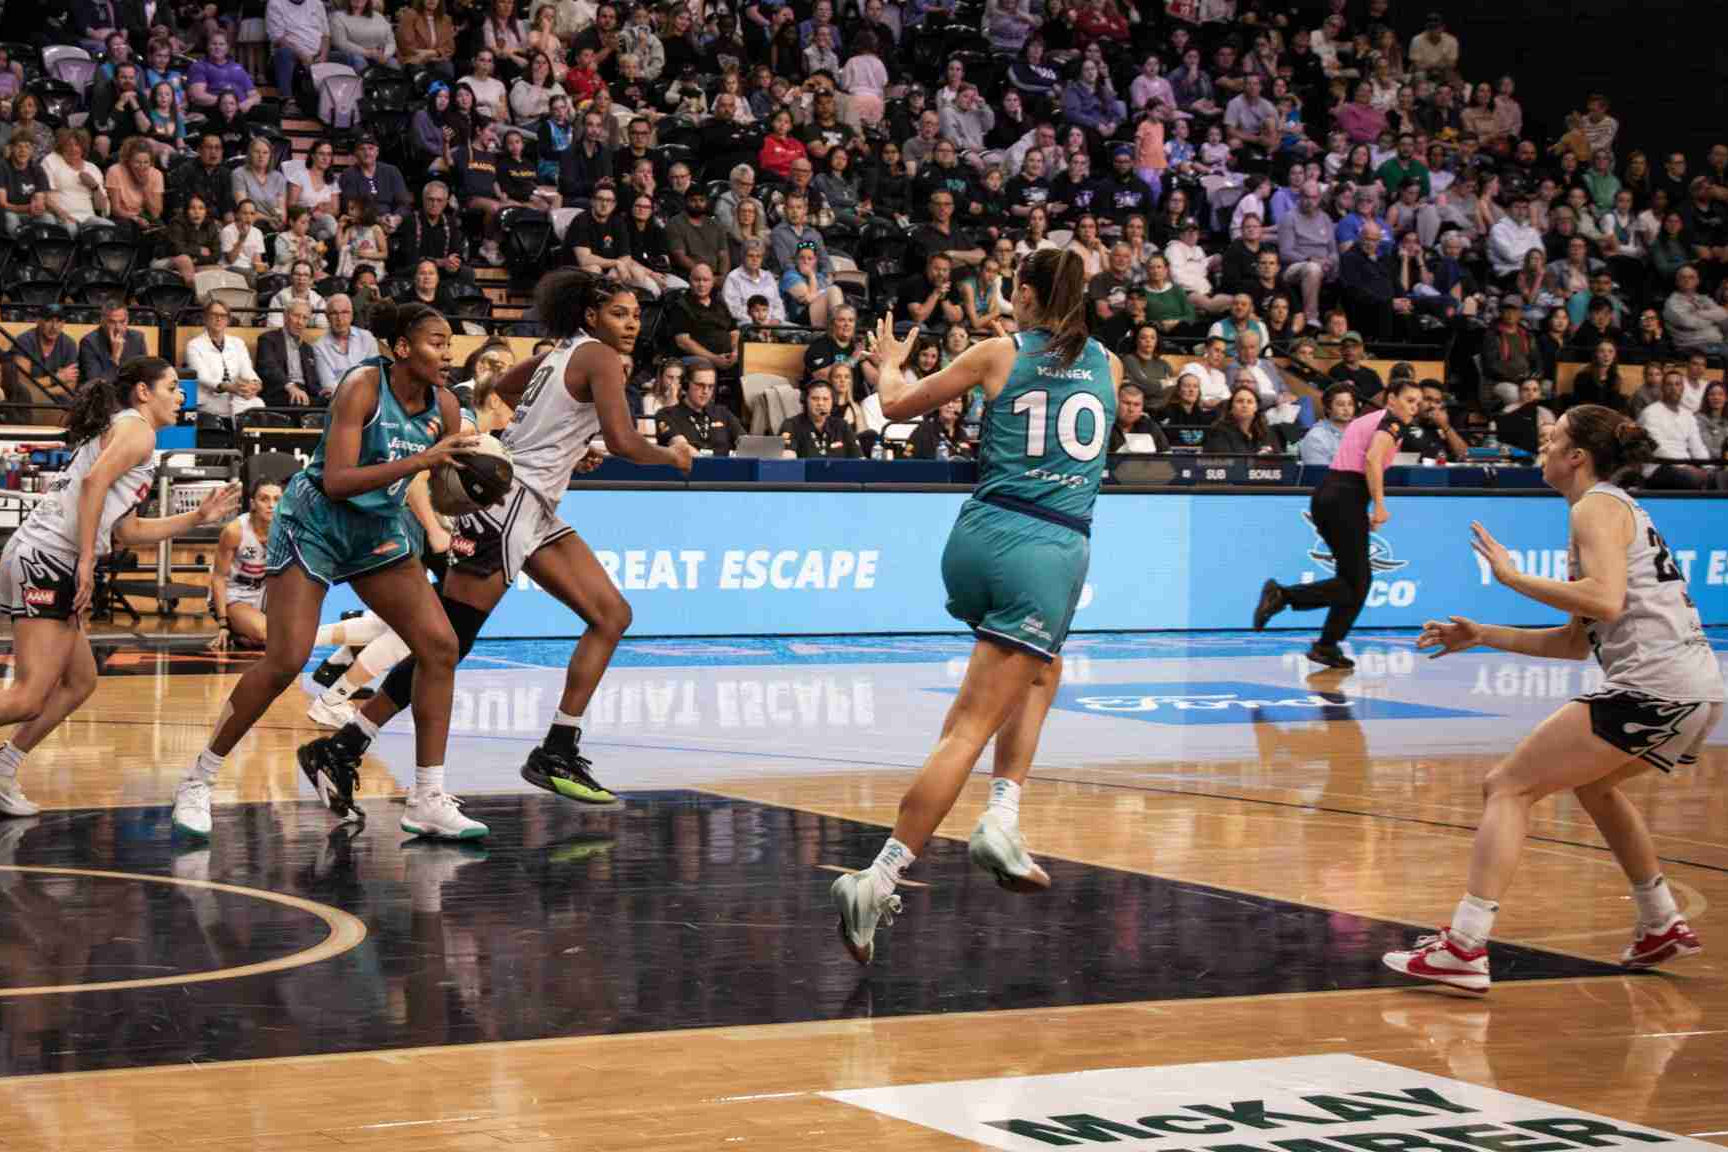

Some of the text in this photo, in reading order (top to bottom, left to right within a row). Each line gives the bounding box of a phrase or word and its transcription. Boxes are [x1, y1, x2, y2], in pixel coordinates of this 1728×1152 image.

[1011, 388, 1107, 463] 10
[1247, 468, 1282, 480] BONUS
[598, 549, 880, 590] REAT ESCAPE
[981, 1087, 1483, 1147] McKAY
